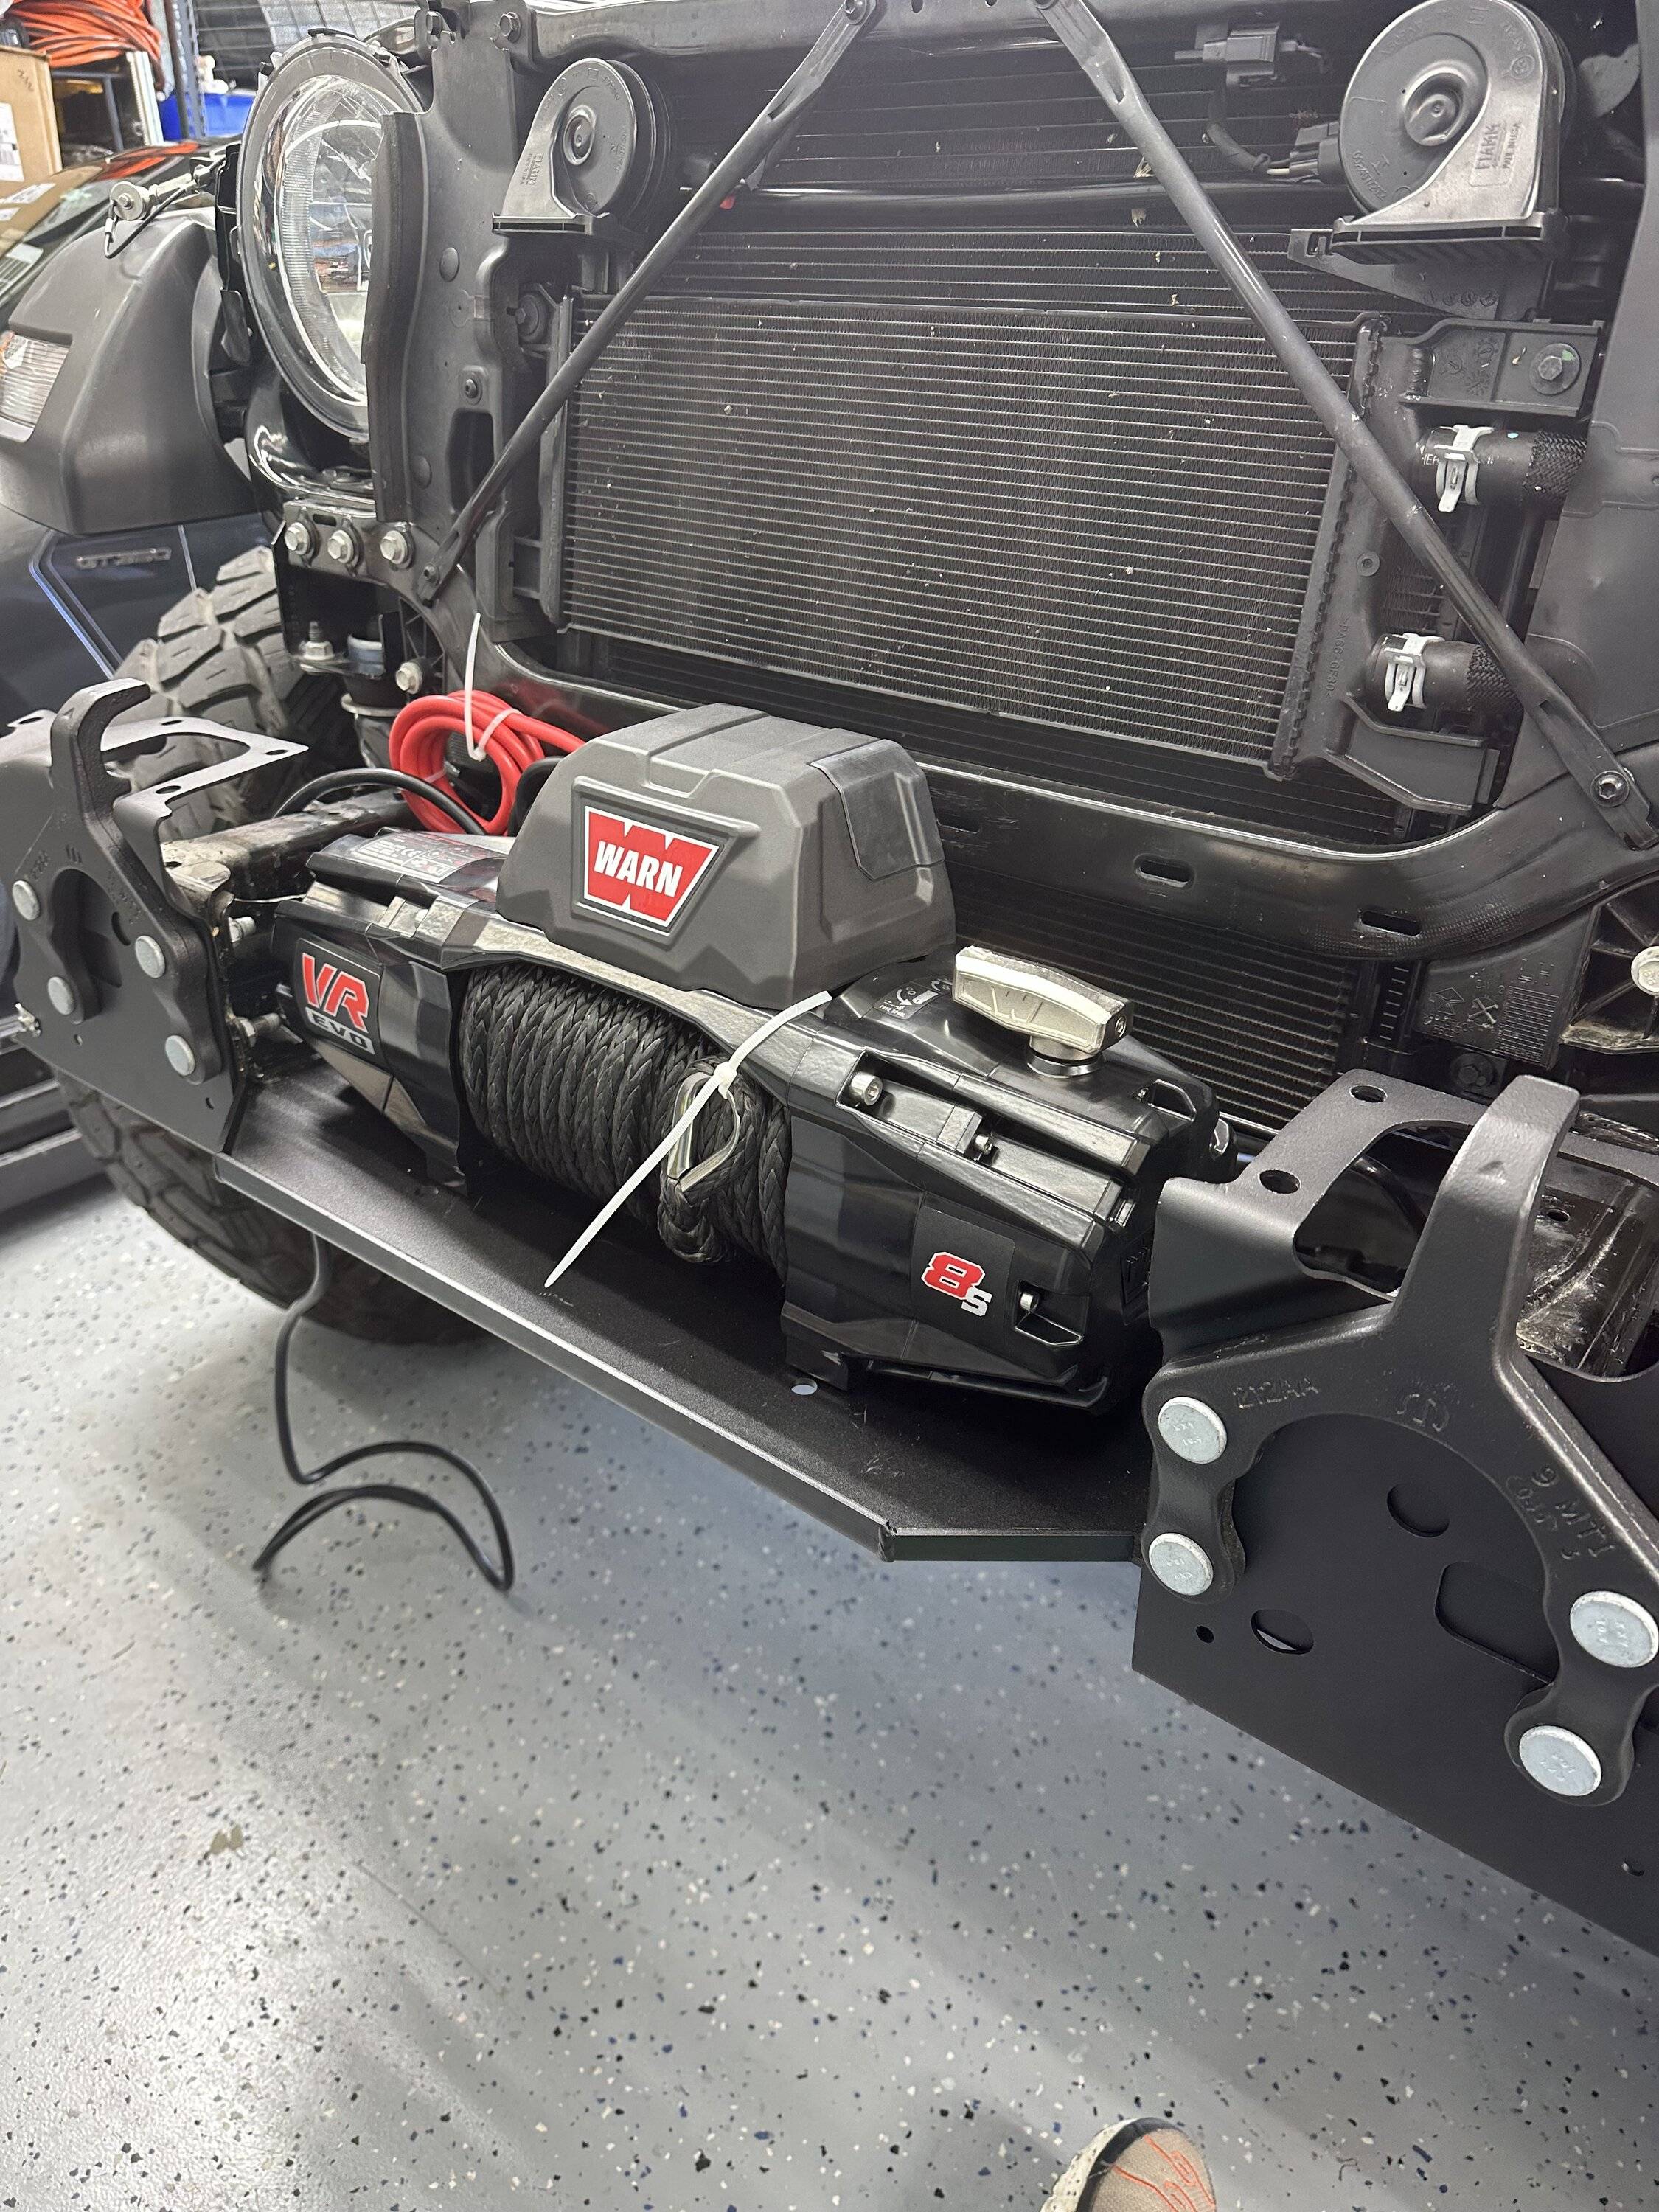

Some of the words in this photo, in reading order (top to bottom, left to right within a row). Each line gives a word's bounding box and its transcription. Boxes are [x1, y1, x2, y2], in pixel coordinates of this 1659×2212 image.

[594, 841, 683, 897] WARN
[302, 953, 369, 1033] VR
[312, 1013, 368, 1049] EVO
